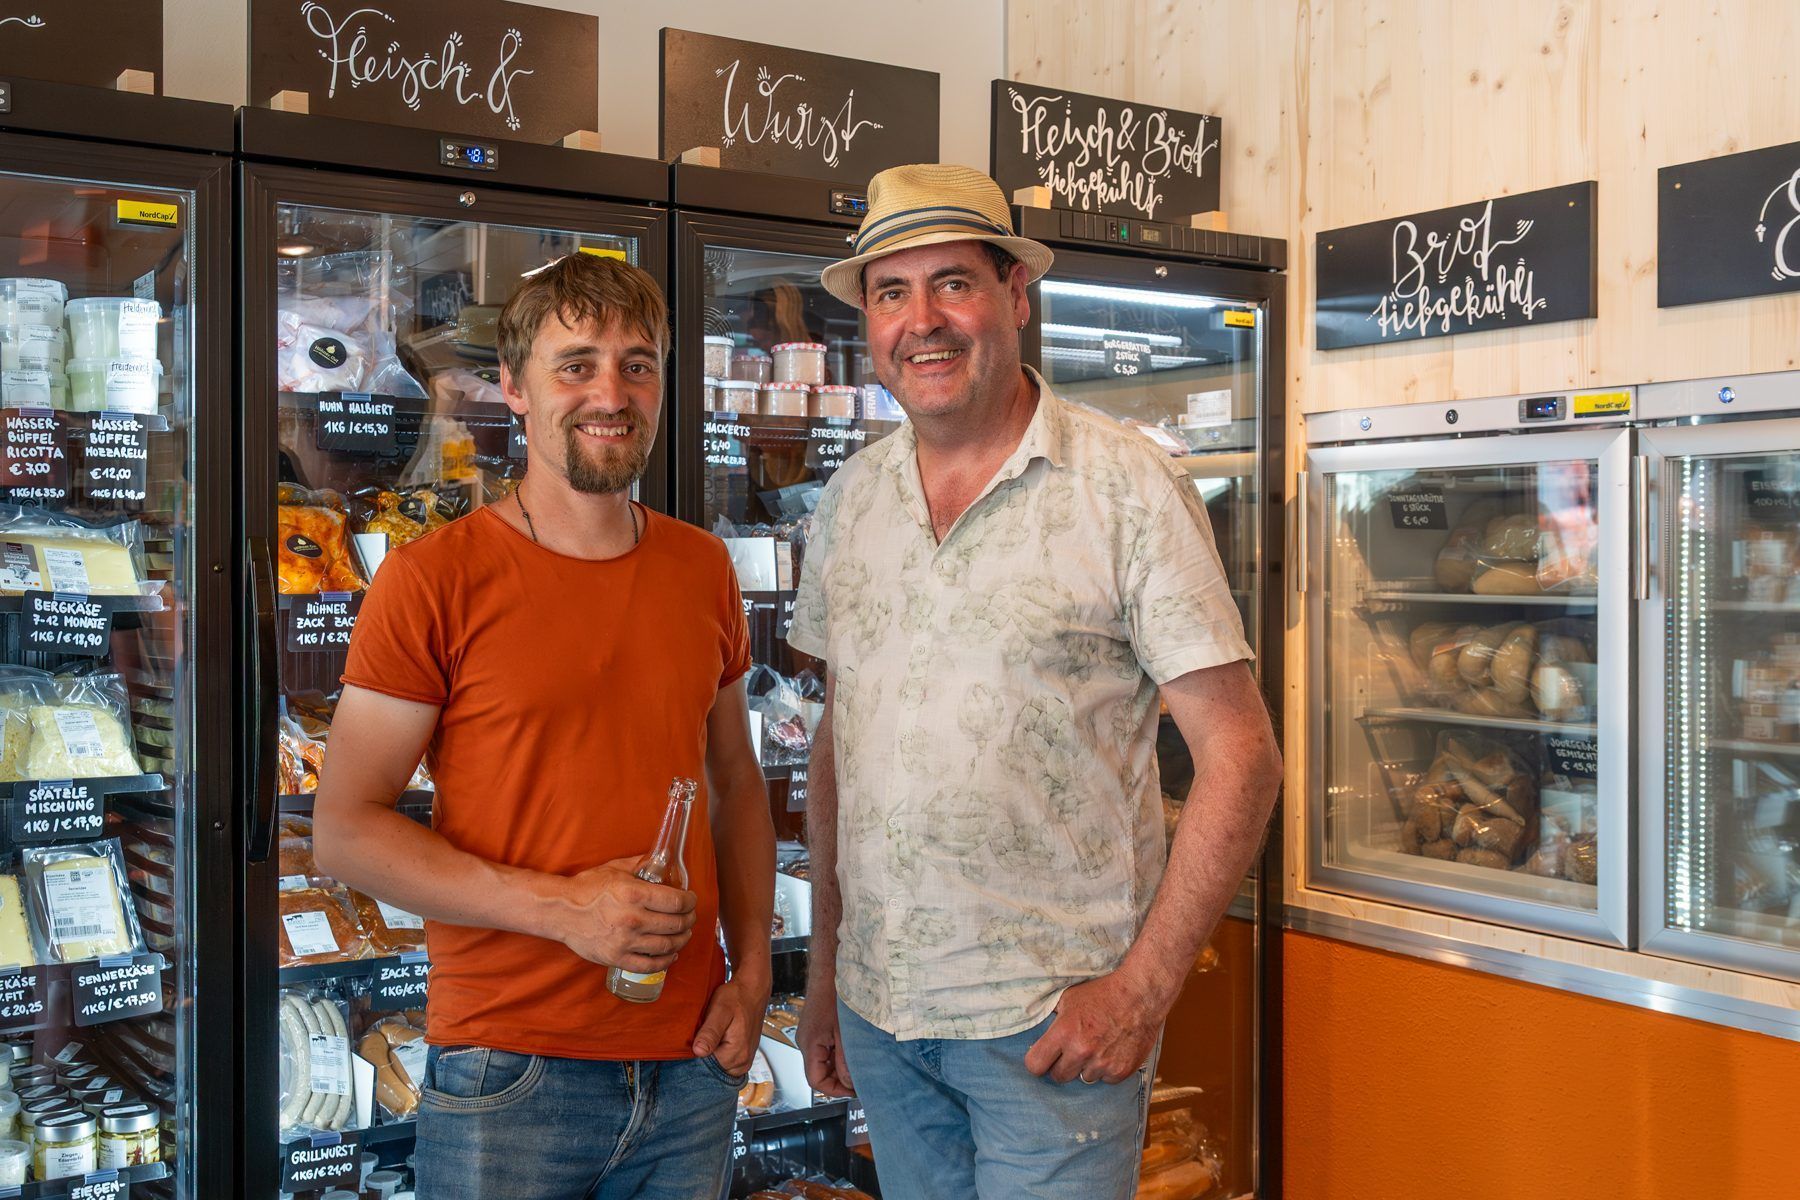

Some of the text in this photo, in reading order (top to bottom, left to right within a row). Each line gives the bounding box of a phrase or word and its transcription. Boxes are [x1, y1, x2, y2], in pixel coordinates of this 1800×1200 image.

[301, 2, 534, 130] Fleisch &
[716, 59, 883, 167] Wurst
[1009, 88, 1218, 178] Fleisch & Brot
[139, 210, 170, 220] NordCap
[1392, 200, 1534, 298] Brot
[319, 400, 394, 416] HUHN HALBIERT
[6, 417, 60, 431] WASSER-
[91, 419, 143, 432] WASSER-
[8, 429, 55, 445] BÜFFEL
[89, 431, 139, 446] BÜFFEL
[6, 445, 64, 459] RICOTTA
[34, 598, 102, 616] BERGKÄSE
[306, 602, 347, 615] HÜHNER
[32, 614, 107, 630] 7-12 MONATE
[296, 617, 325, 629] ZACK
[29, 786, 88, 801] SPÄTZLE
[25, 798, 95, 815] MISCHUNG
[78, 964, 155, 987] SENNERKÄSE
[380, 964, 431, 980] ZACK ZA
[94, 979, 139, 996] 45% FIT
[849, 1108, 866, 1121] WIE
[291, 1143, 357, 1165] GRILLWURST
[71, 1180, 126, 1200] ZIEGEN-
